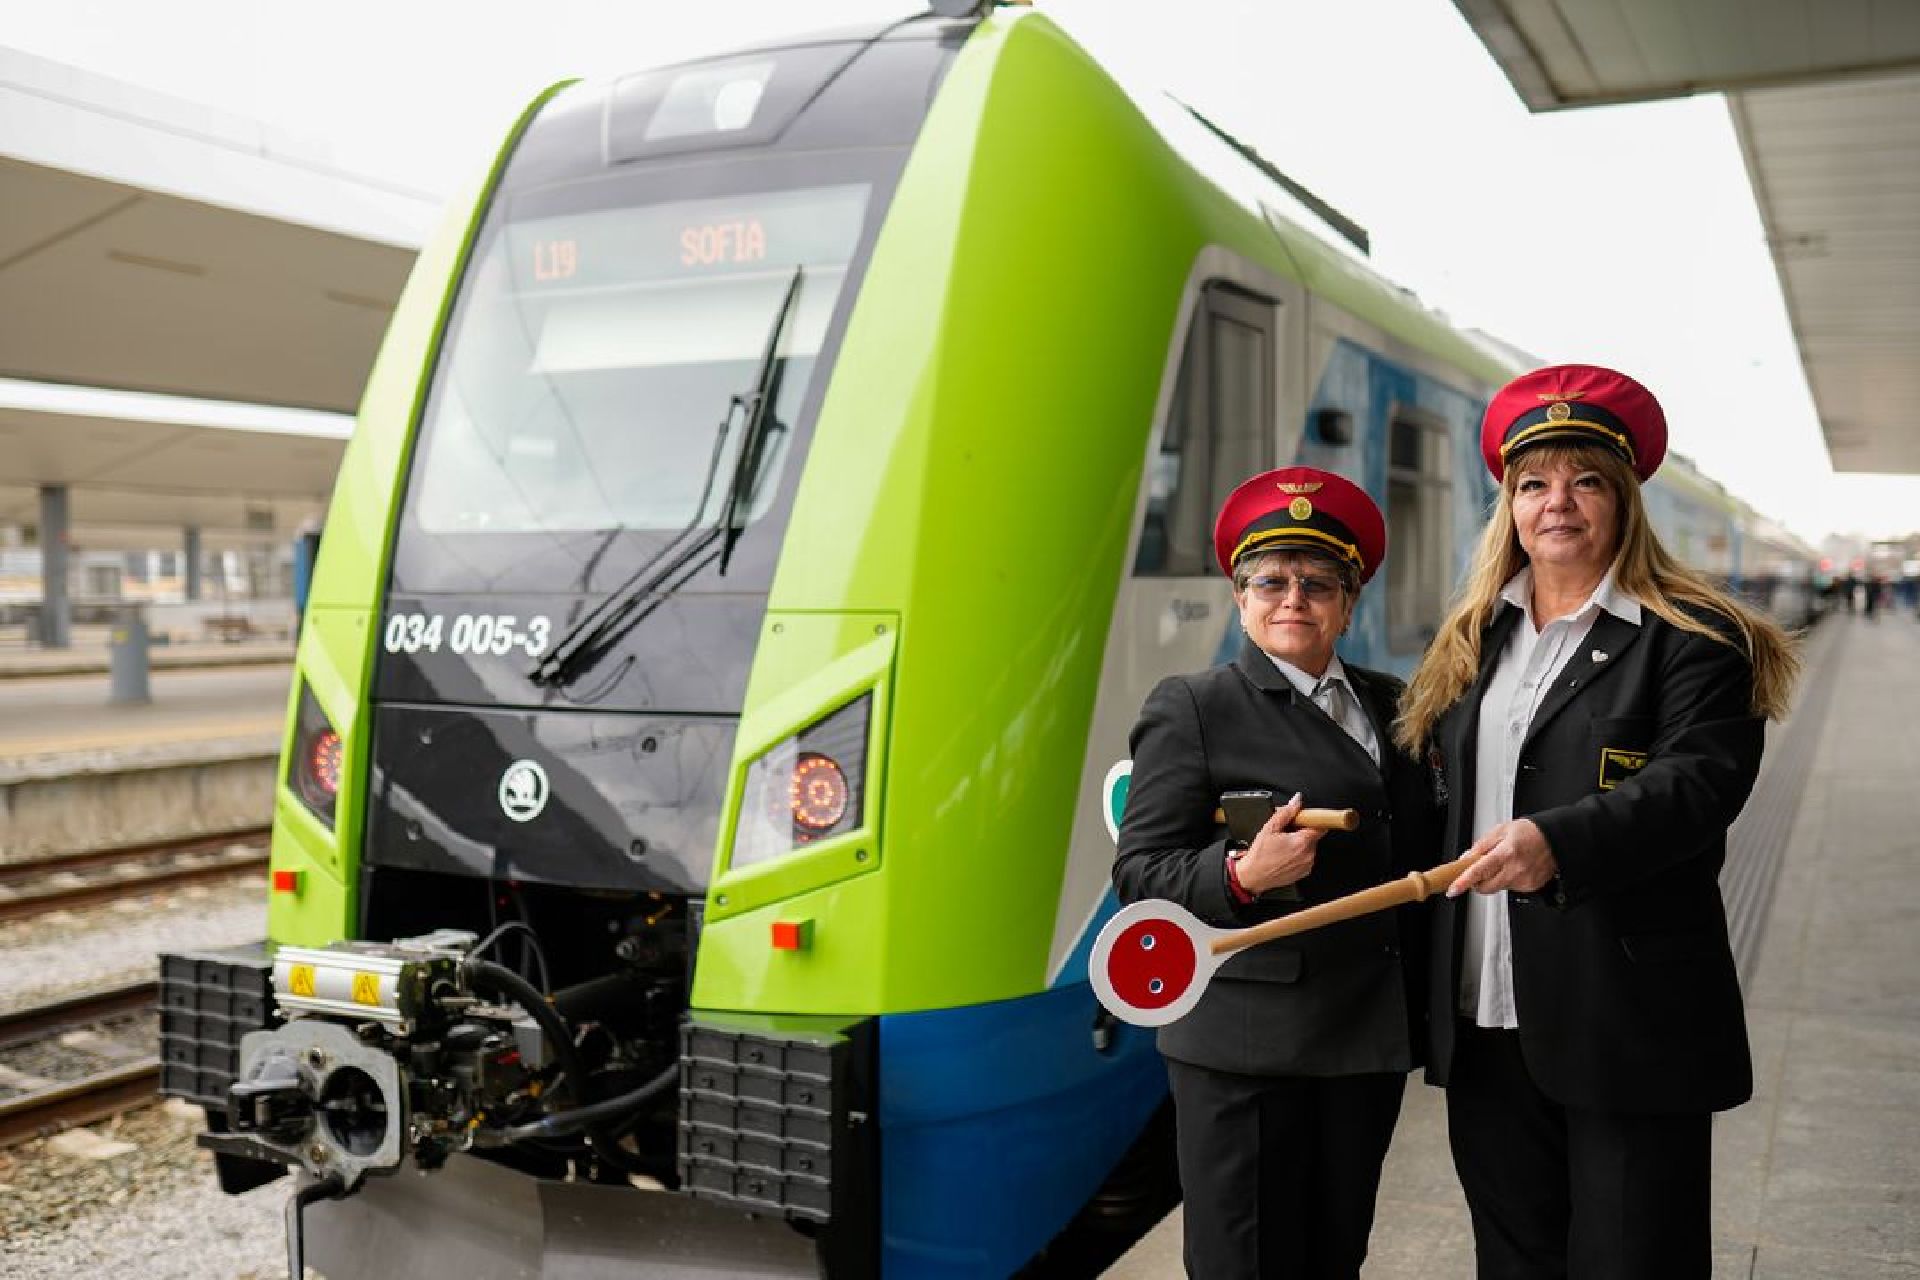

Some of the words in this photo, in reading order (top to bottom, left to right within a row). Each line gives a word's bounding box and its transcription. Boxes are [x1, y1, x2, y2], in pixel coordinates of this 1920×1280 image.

[533, 240, 577, 281] L19
[680, 220, 767, 266] SOFIA
[385, 613, 444, 654] 034
[452, 613, 552, 656] 005-3
